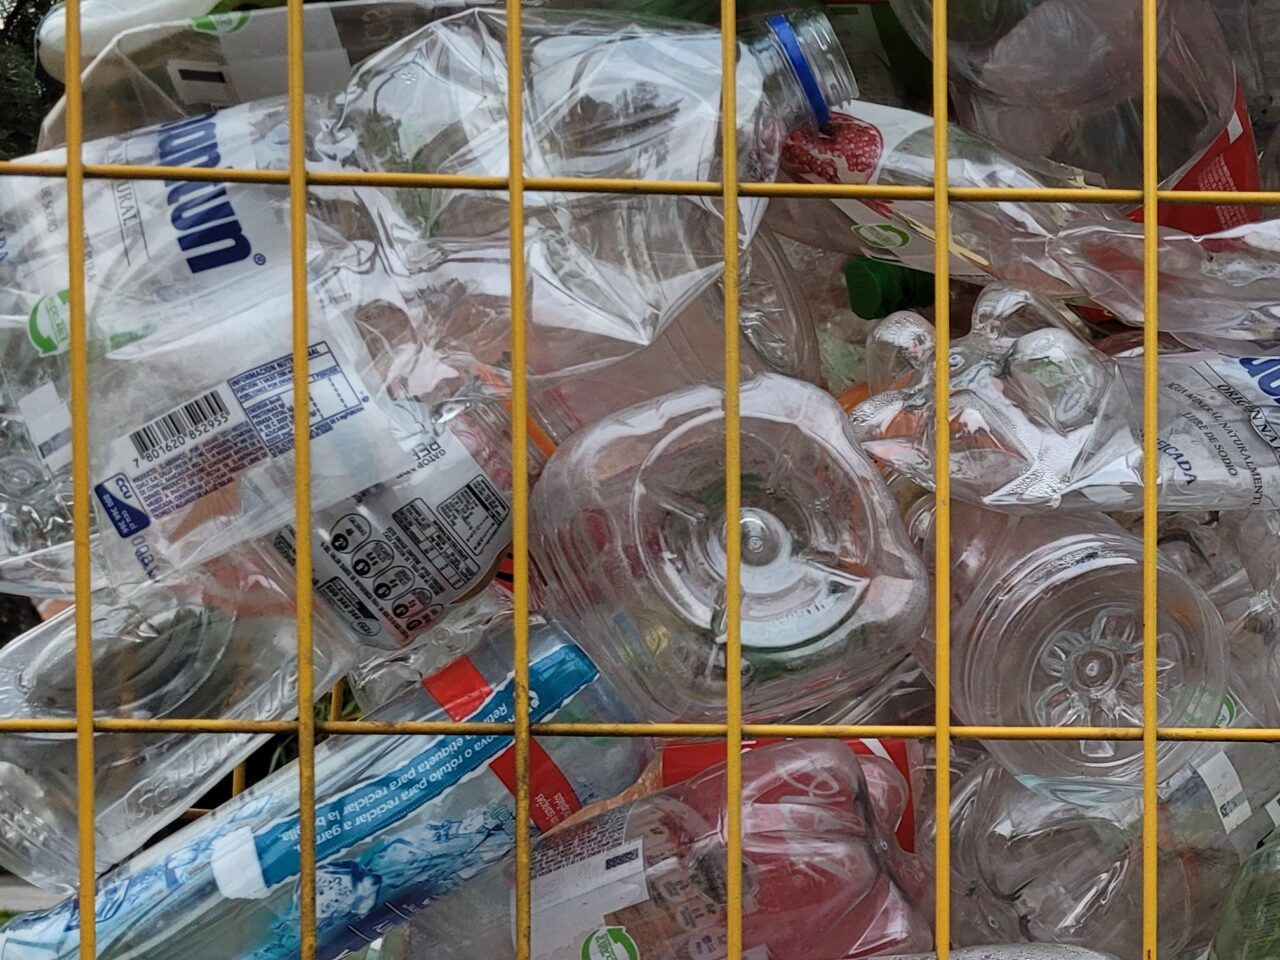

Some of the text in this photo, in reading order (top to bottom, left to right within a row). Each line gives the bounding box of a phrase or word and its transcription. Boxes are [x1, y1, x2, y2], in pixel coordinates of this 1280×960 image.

[132, 411, 230, 469] 7 801620 852955
[1204, 429, 1219, 446] DE
[1213, 441, 1240, 478] SODIO
[114, 476, 133, 501] CCU
[417, 737, 466, 774] etiqueta
[426, 754, 467, 786] rótulo
[386, 767, 419, 792] para
[398, 776, 431, 803] para
[339, 783, 389, 819] reciclar
[352, 794, 402, 830] reciclar
